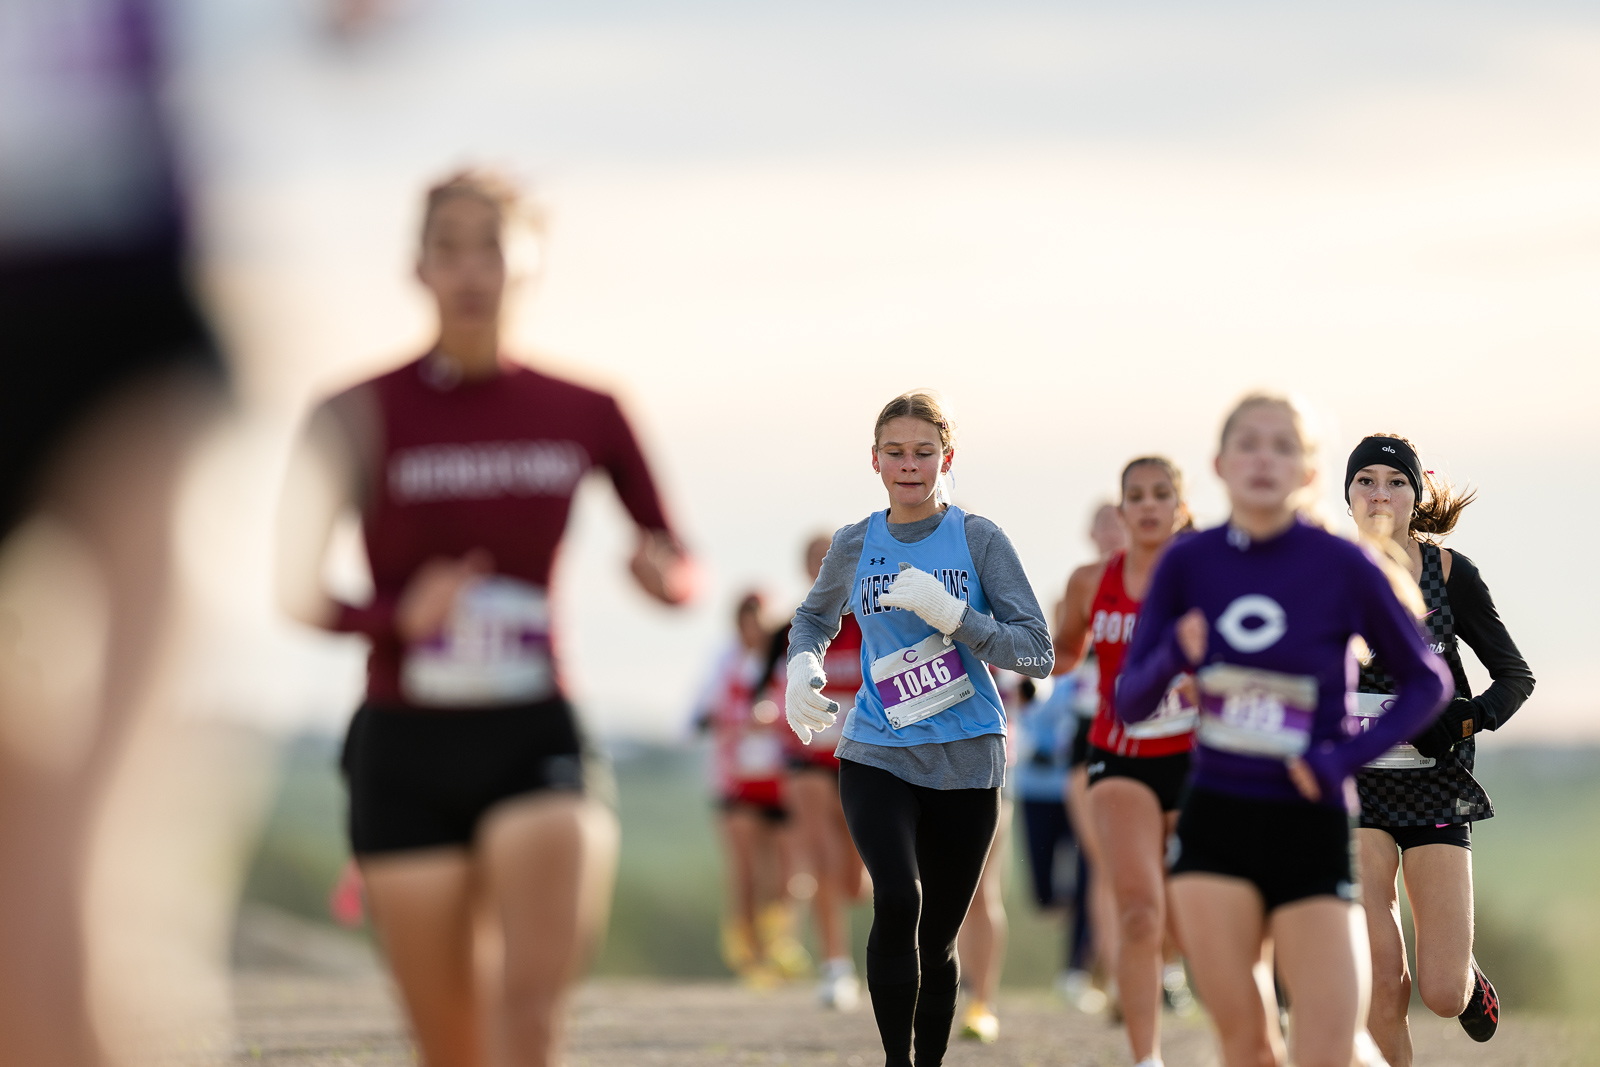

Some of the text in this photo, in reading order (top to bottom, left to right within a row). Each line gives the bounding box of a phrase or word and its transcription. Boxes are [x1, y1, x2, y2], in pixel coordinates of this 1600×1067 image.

[1381, 446, 1396, 454] alo
[1093, 609, 1137, 644] BOR
[893, 657, 952, 702] 1046
[959, 689, 971, 699] 1046
